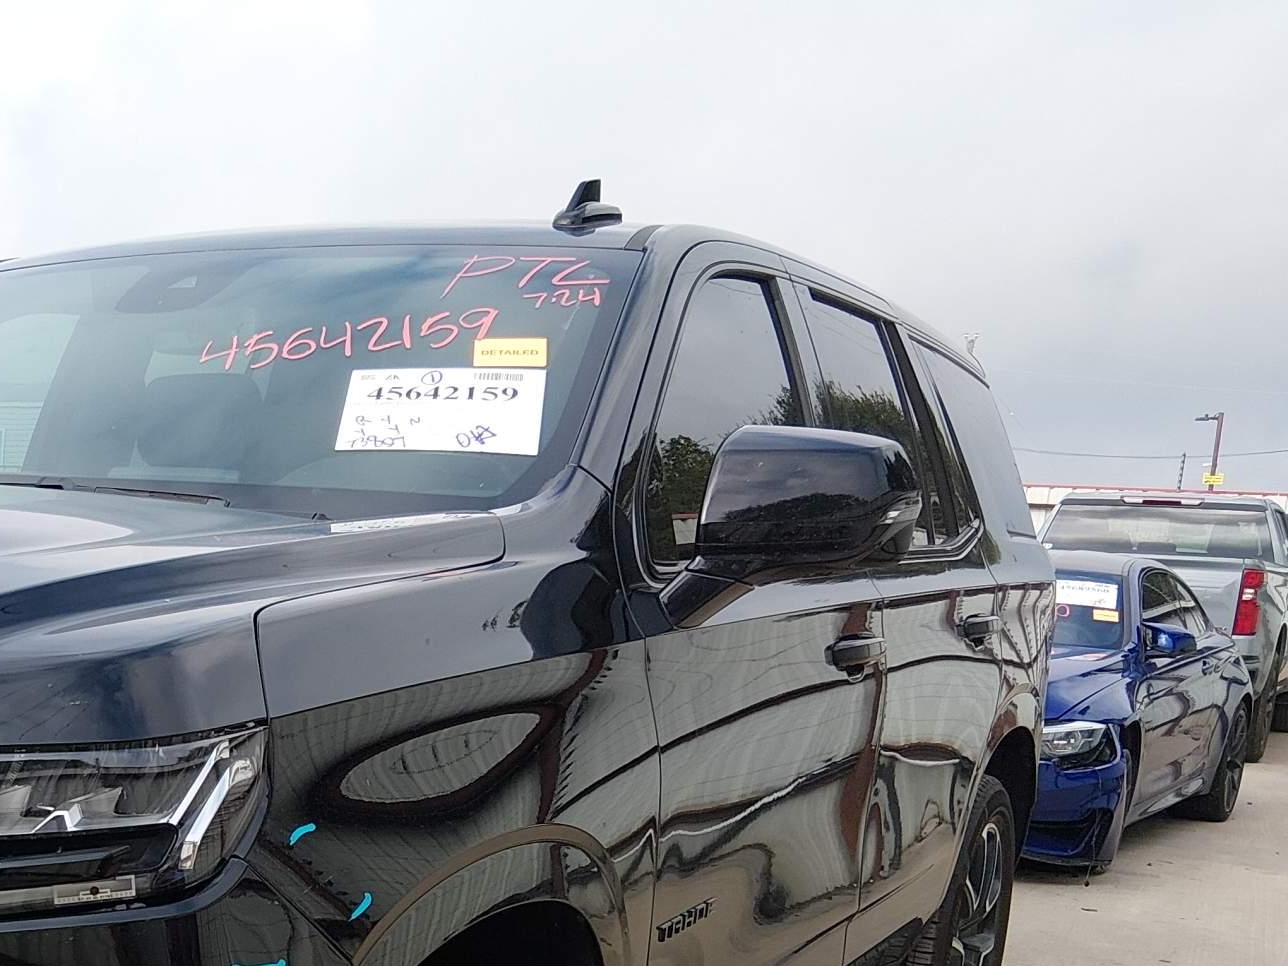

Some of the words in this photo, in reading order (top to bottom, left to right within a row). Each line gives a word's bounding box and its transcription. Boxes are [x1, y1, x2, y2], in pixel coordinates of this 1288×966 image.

[199, 307, 500, 370] 45642159
[480, 349, 540, 357] DETAILED
[367, 386, 519, 402] 45642159
